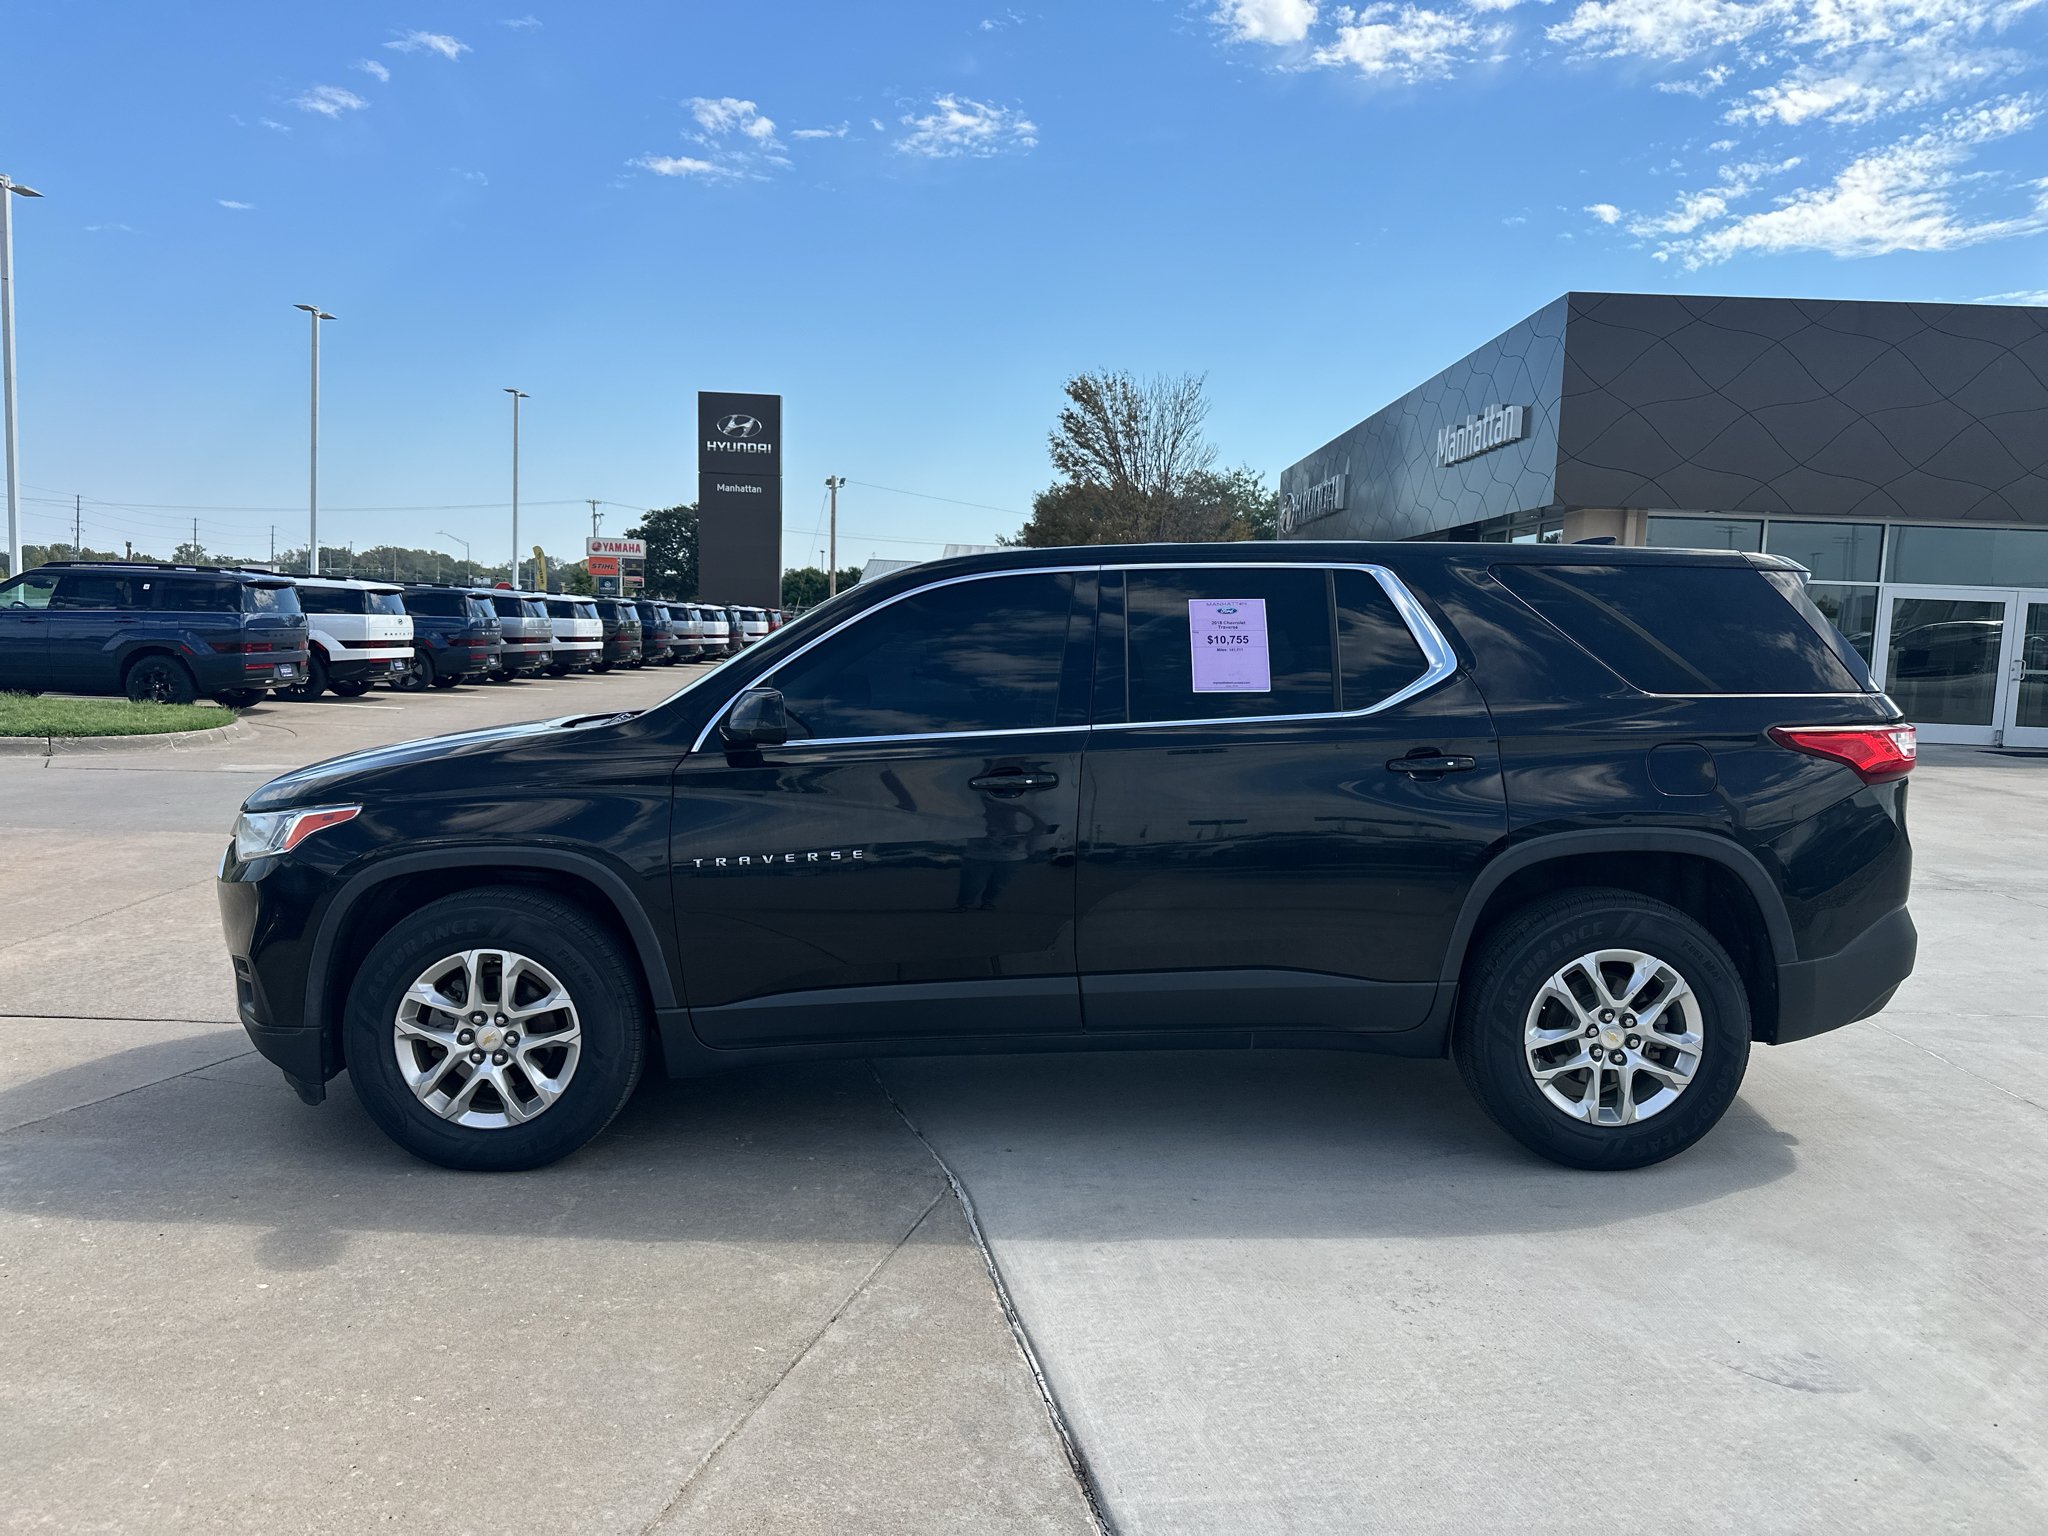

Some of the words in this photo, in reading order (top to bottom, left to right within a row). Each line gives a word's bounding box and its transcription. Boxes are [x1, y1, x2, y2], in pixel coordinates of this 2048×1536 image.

[1436, 404, 1522, 467] Manhattan
[707, 440, 771, 454] HYUNDAI
[717, 483, 762, 494] Manhattan
[602, 542, 641, 553] YAMAHA
[1207, 635, 1249, 645] $10,755
[693, 850, 863, 868] TRAVERSE
[1503, 921, 1613, 1015] ASSURANCE
